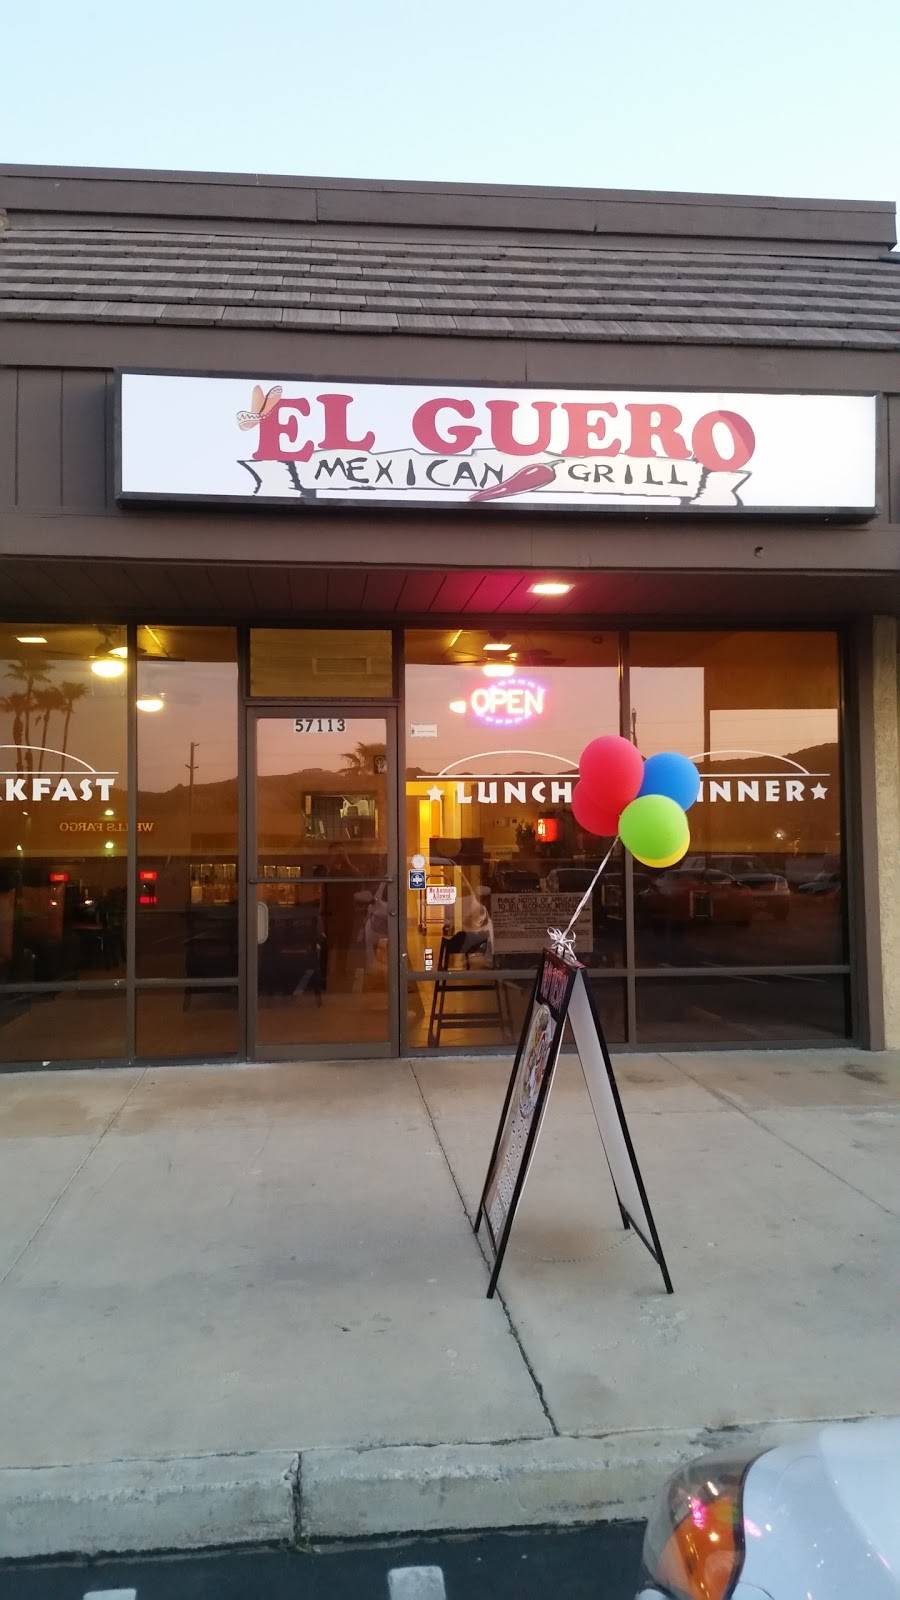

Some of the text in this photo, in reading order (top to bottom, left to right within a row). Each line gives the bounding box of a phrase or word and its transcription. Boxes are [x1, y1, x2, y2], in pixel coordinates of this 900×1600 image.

[252, 394, 755, 472] EL GUERO
[315, 457, 688, 488] MEXICAN GRILL
[471, 689, 545, 715] OPEN
[294, 719, 346, 733] 57113
[0, 778, 115, 801] KFAST
[456, 781, 572, 804] LUNCH
[697, 780, 805, 803] INNER
